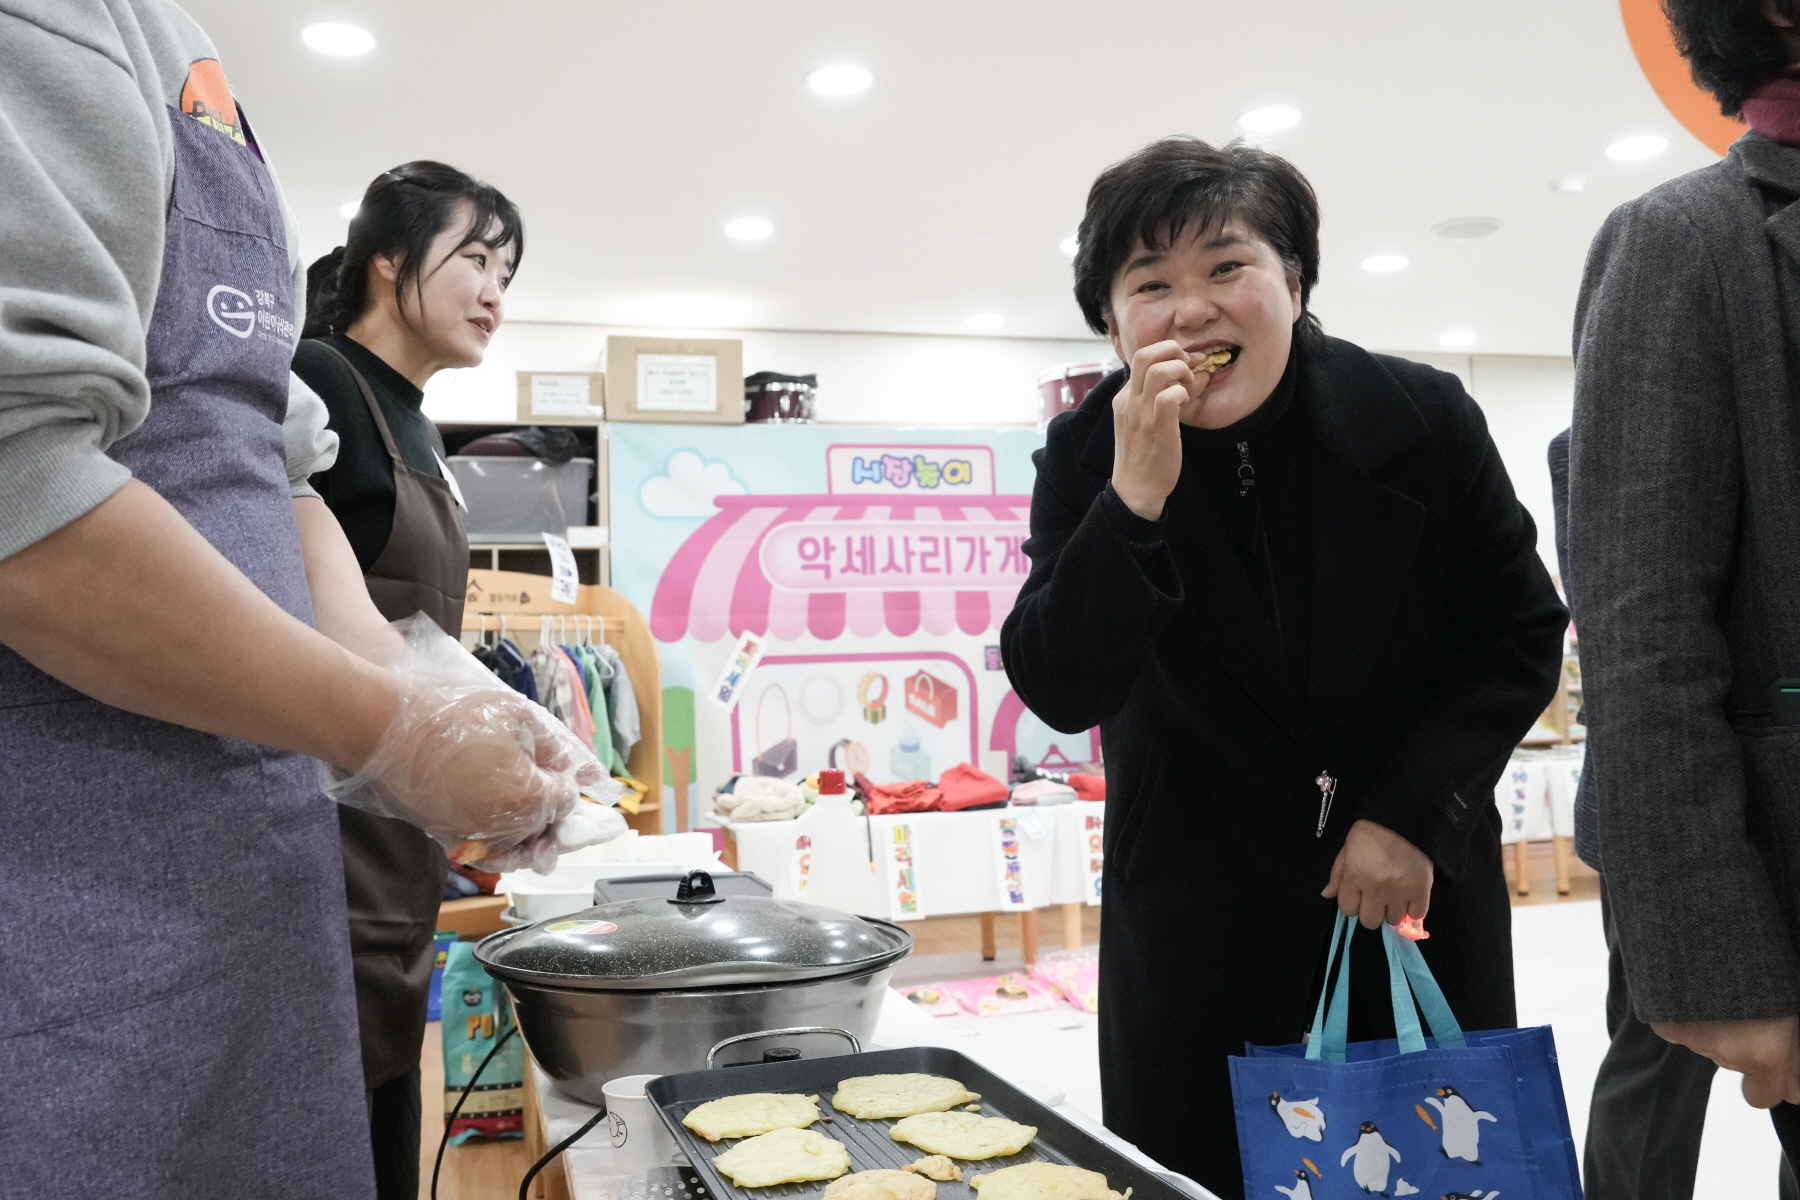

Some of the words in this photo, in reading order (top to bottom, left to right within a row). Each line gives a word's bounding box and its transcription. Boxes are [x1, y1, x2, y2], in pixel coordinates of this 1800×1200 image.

[255, 289, 275, 310] 강북구
[257, 309, 295, 340] 어린이급식관리
[852, 454, 972, 488] 시장놀이
[798, 536, 1028, 580] 악세사리가게
